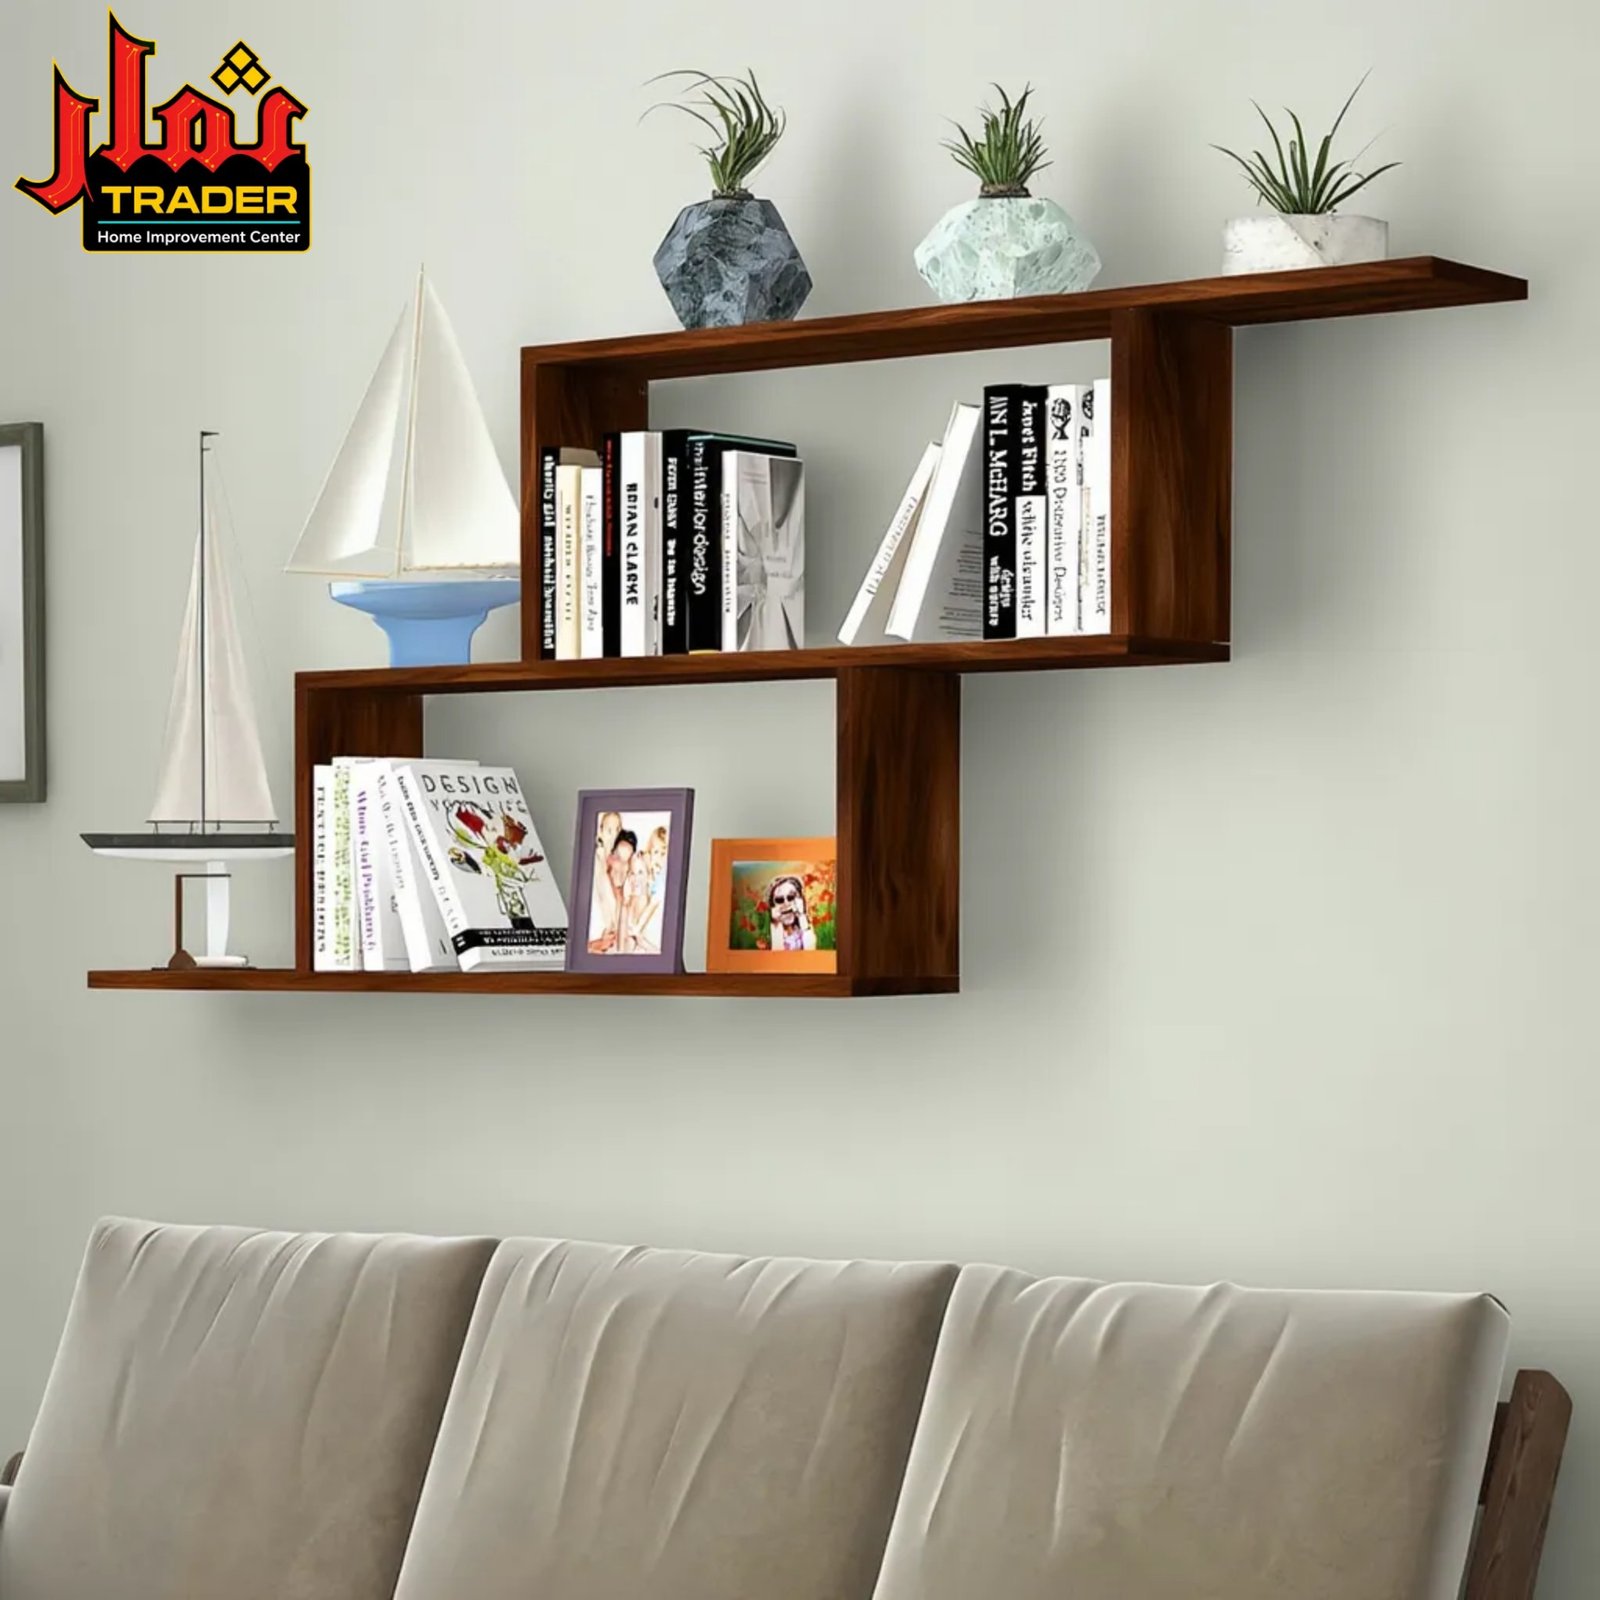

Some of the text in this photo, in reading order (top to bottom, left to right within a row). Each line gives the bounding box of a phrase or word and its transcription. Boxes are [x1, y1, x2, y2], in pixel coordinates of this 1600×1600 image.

[625, 482, 639, 606] BRIAN CLARKE
[421, 774, 520, 795] DESIGN
